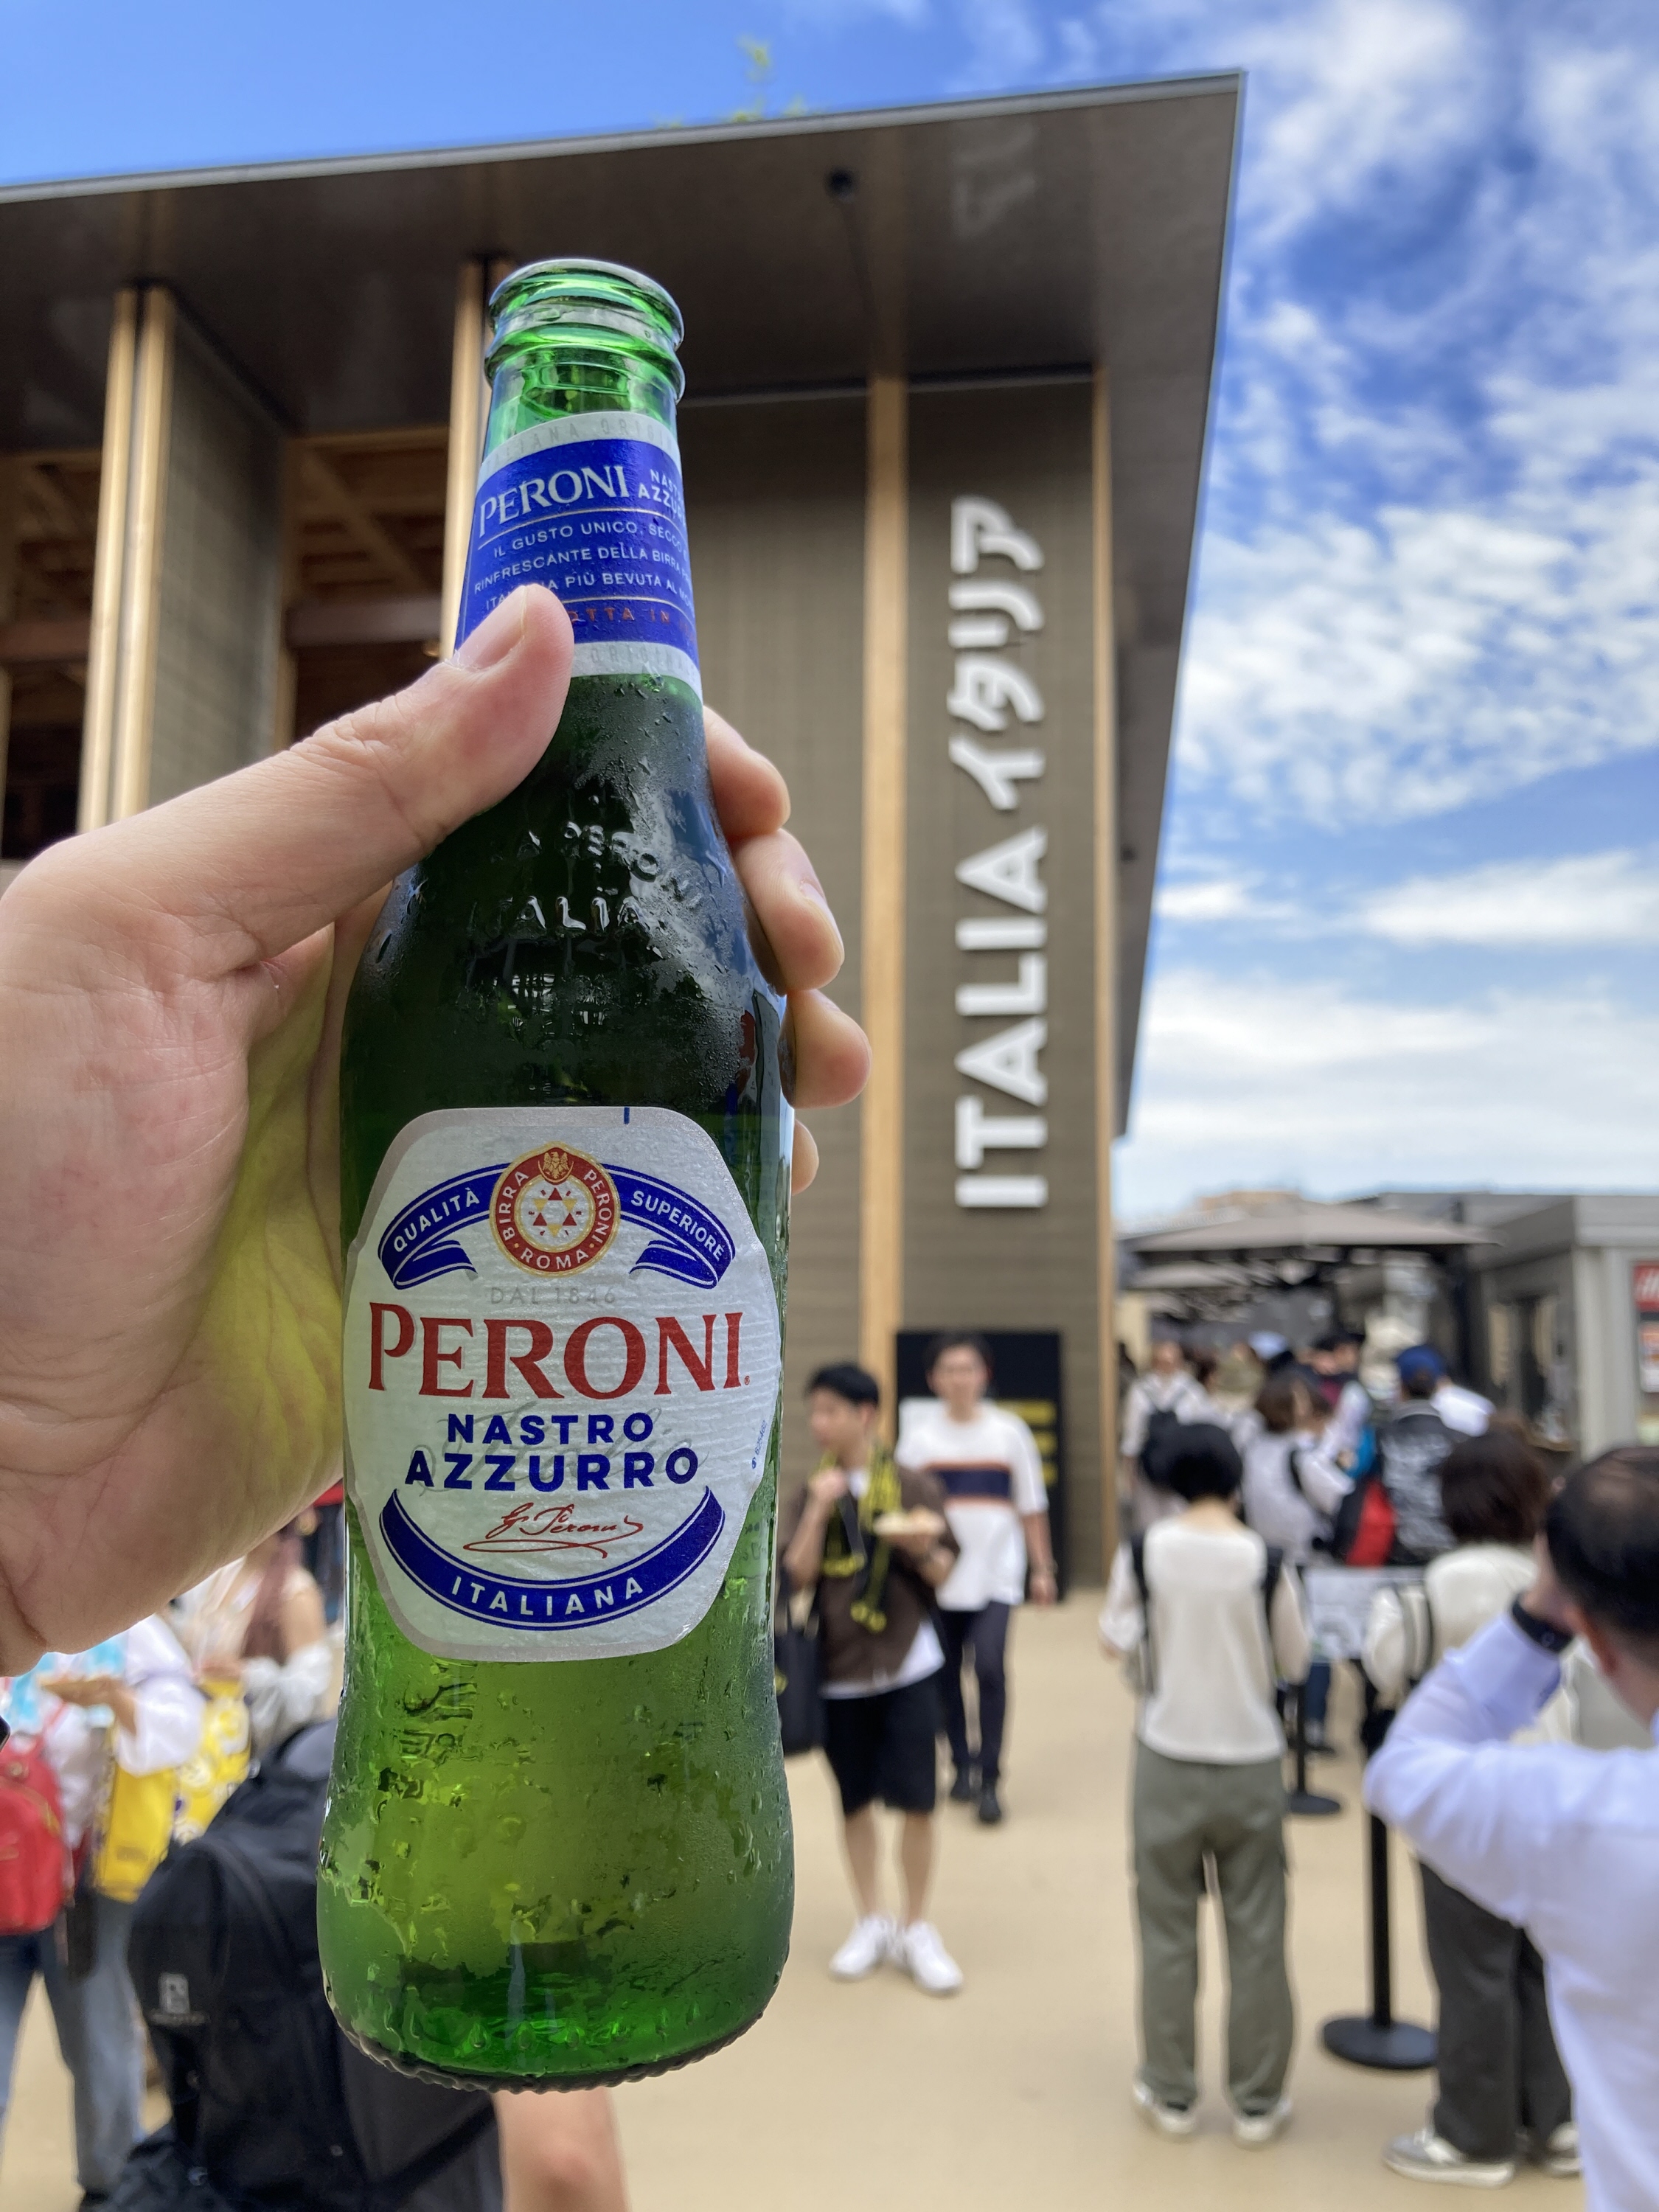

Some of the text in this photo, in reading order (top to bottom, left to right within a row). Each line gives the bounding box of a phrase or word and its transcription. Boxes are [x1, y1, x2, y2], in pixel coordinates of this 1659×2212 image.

[479, 465, 630, 538] PERONI
[494, 546, 506, 559] IL
[512, 525, 574, 551] GUSTO
[581, 520, 644, 536] UNICO,
[649, 524, 683, 554] SECCO
[474, 549, 593, 594] RINFRESCANTE
[598, 543, 648, 560] DELLA
[653, 551, 681, 575] BIRRA
[565, 570, 595, 588] PIÙ
[602, 571, 661, 589] BEVUTA
[667, 581, 678, 594] AL
[650, 606, 670, 625] IN
[947, 493, 1048, 1208] ITALIA イタリア
[393, 1187, 480, 1253] QUALITÀ
[503, 1170, 529, 1241] BIRRA
[583, 1169, 611, 1245] PERONI
[631, 1190, 725, 1261] SUPERIORE
[520, 1247, 588, 1269] ROMA
[491, 1284, 617, 1305] DAL 1846
[369, 1302, 743, 1399] PERONI
[447, 1412, 653, 1445] NASTRO
[404, 1447, 699, 1492] AZZURRO
[451, 1576, 643, 1616] ITALIANA
